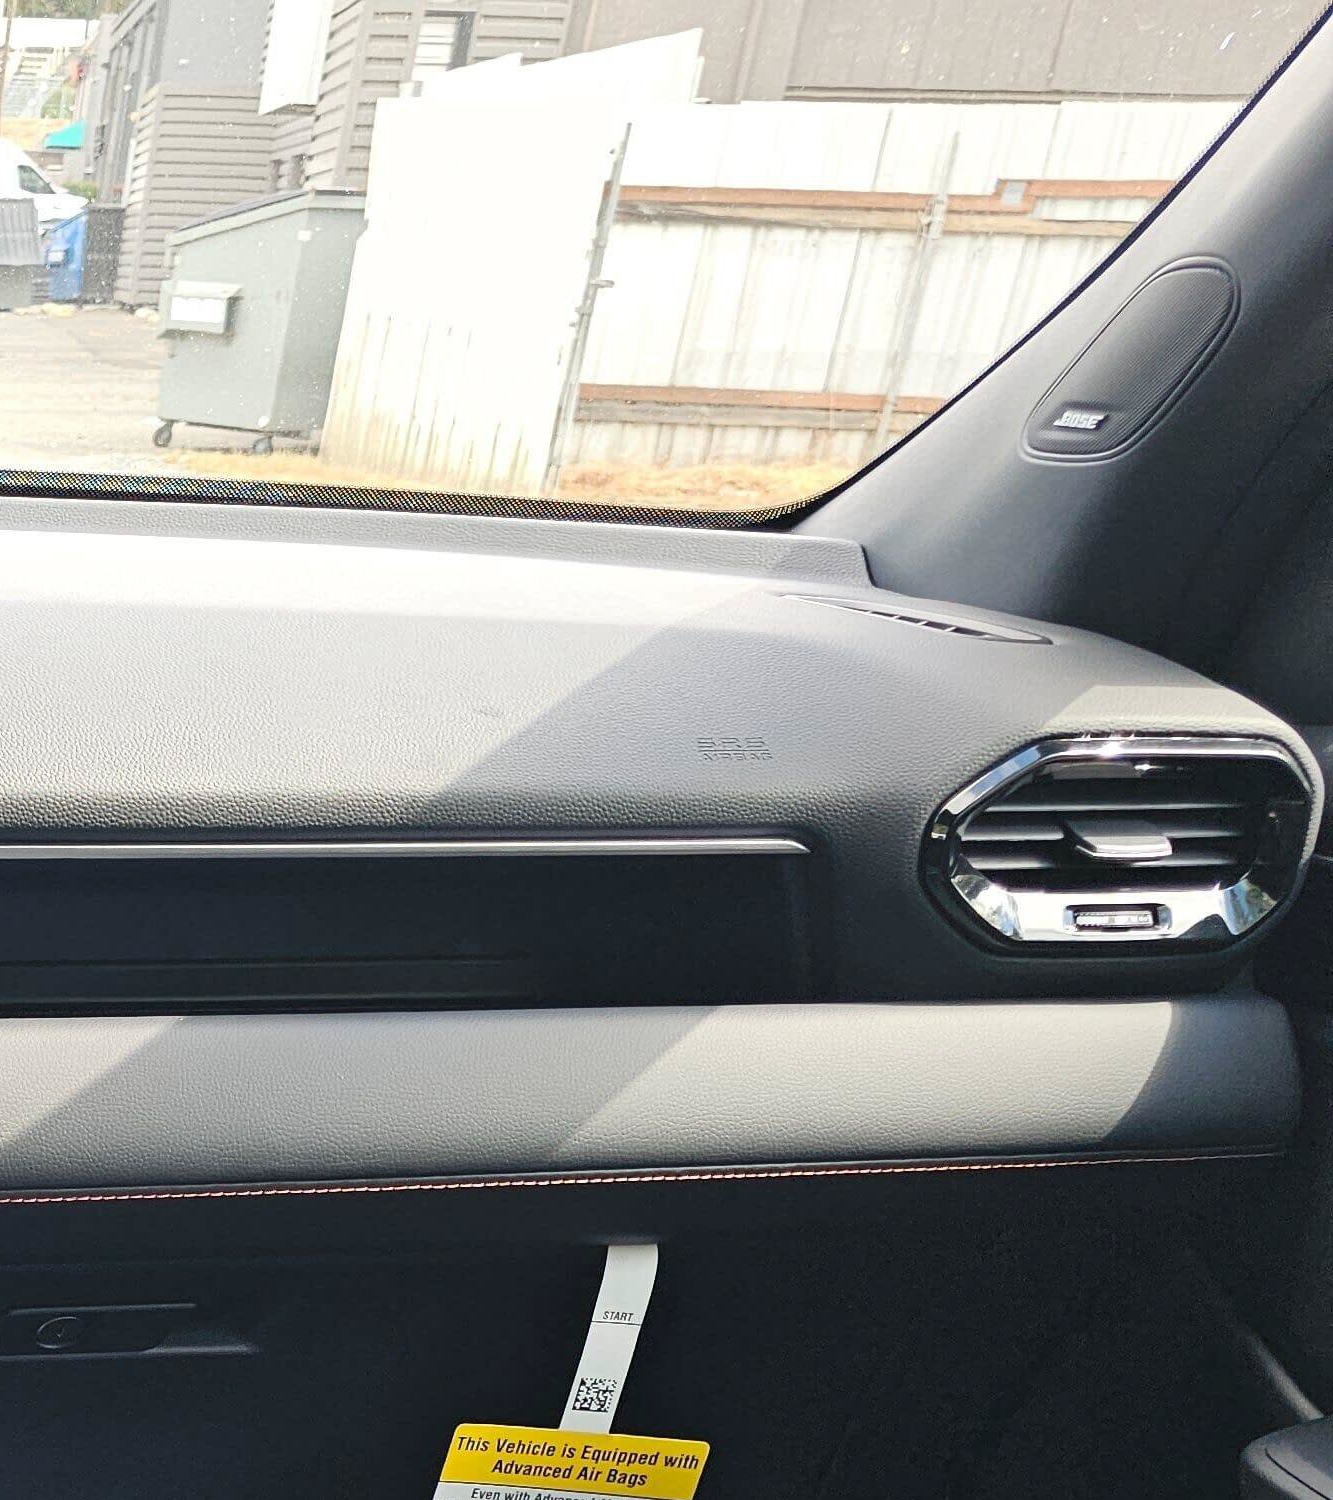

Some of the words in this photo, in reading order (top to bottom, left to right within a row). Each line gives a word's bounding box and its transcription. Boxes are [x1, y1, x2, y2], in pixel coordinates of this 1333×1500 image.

[1054, 410, 1109, 430] BOSE
[603, 1311, 634, 1322] START
[457, 1436, 490, 1452] This
[496, 1438, 557, 1457] Vehicle
[561, 1444, 576, 1458] is
[581, 1446, 660, 1466] Equipped
[664, 1454, 699, 1470] with
[491, 1460, 573, 1479] Advanced
[577, 1466, 603, 1482] Air
[607, 1469, 648, 1488] Bags
[471, 1488, 501, 1500] Even
